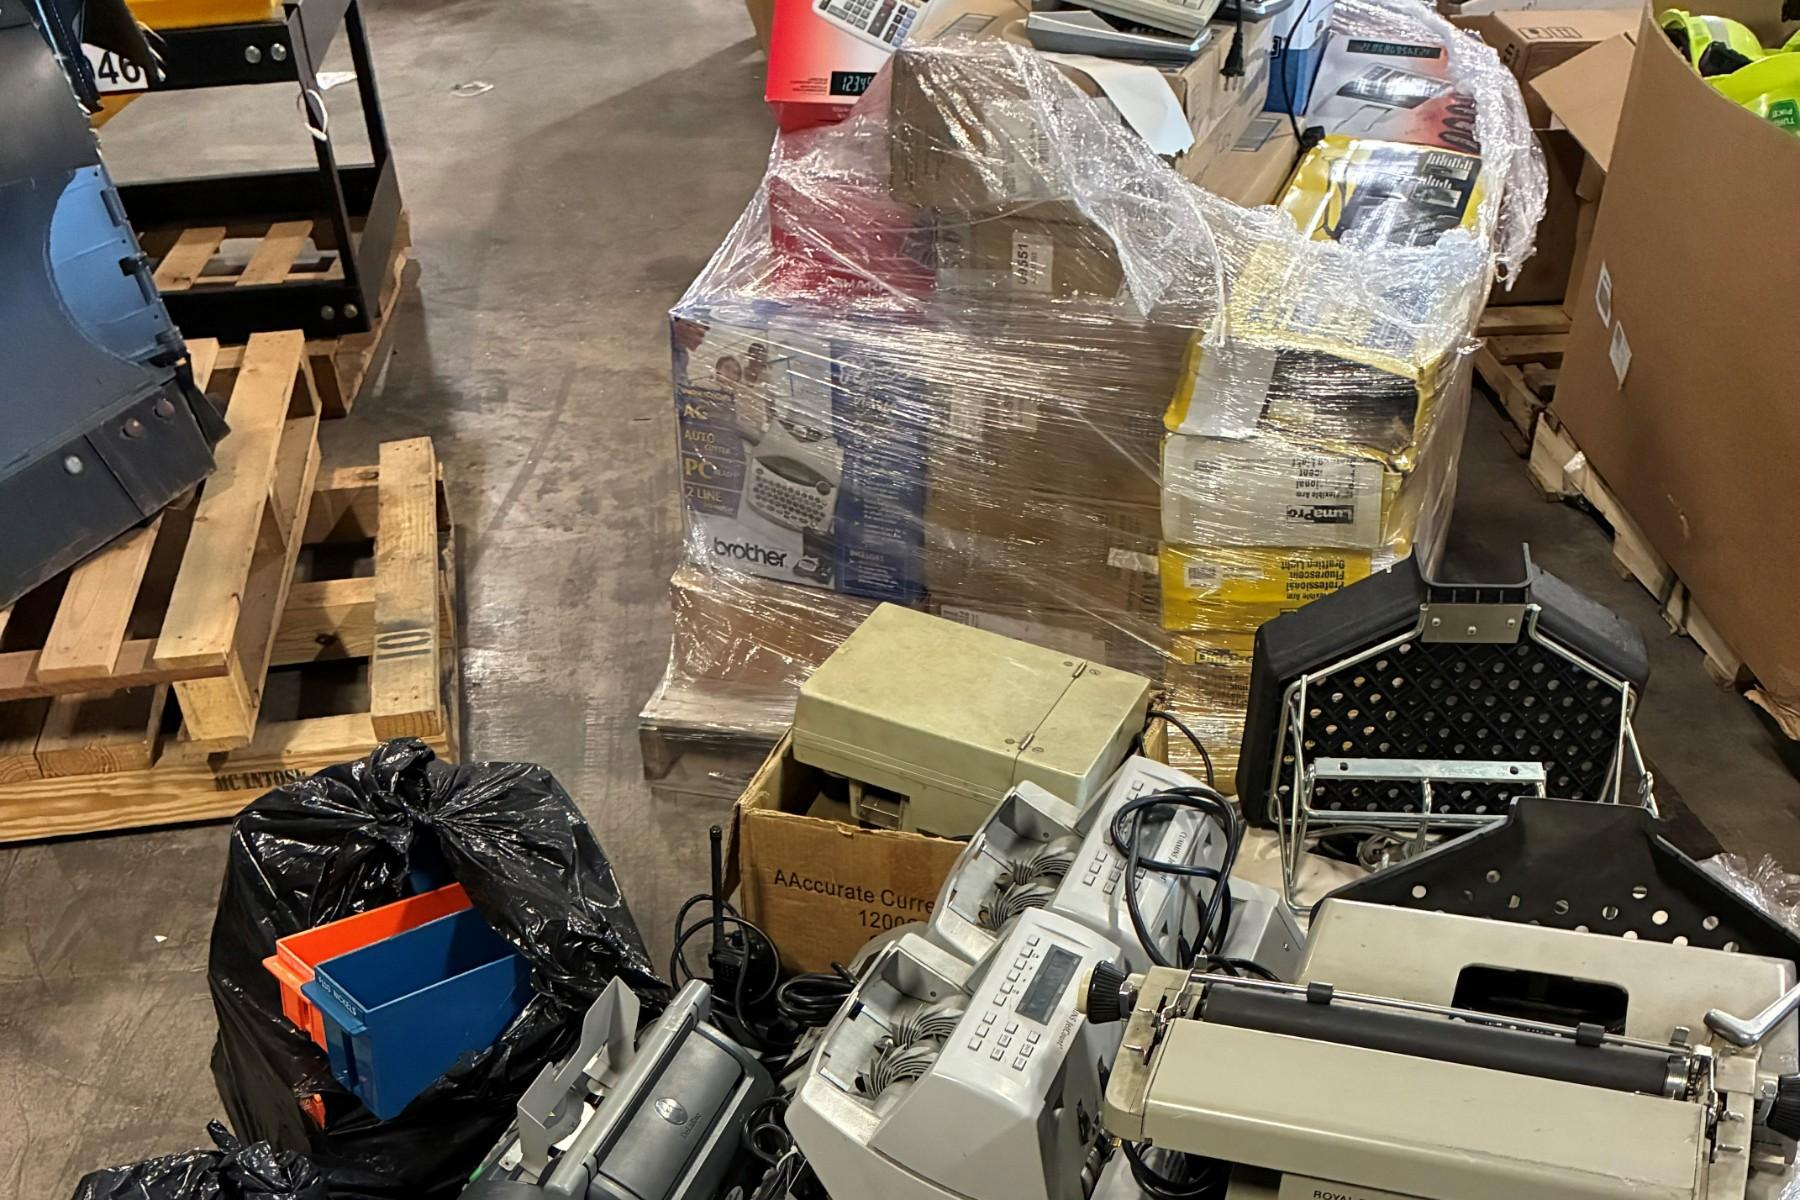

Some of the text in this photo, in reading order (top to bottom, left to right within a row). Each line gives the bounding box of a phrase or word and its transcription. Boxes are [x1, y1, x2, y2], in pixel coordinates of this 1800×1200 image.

[685, 430, 715, 444] AUTO
[685, 458, 712, 480] PC
[696, 487, 722, 503] LINE
[714, 537, 787, 567] brother
[1289, 570, 1345, 580] Fluorescent
[773, 868, 935, 914] AAccurate Curre
